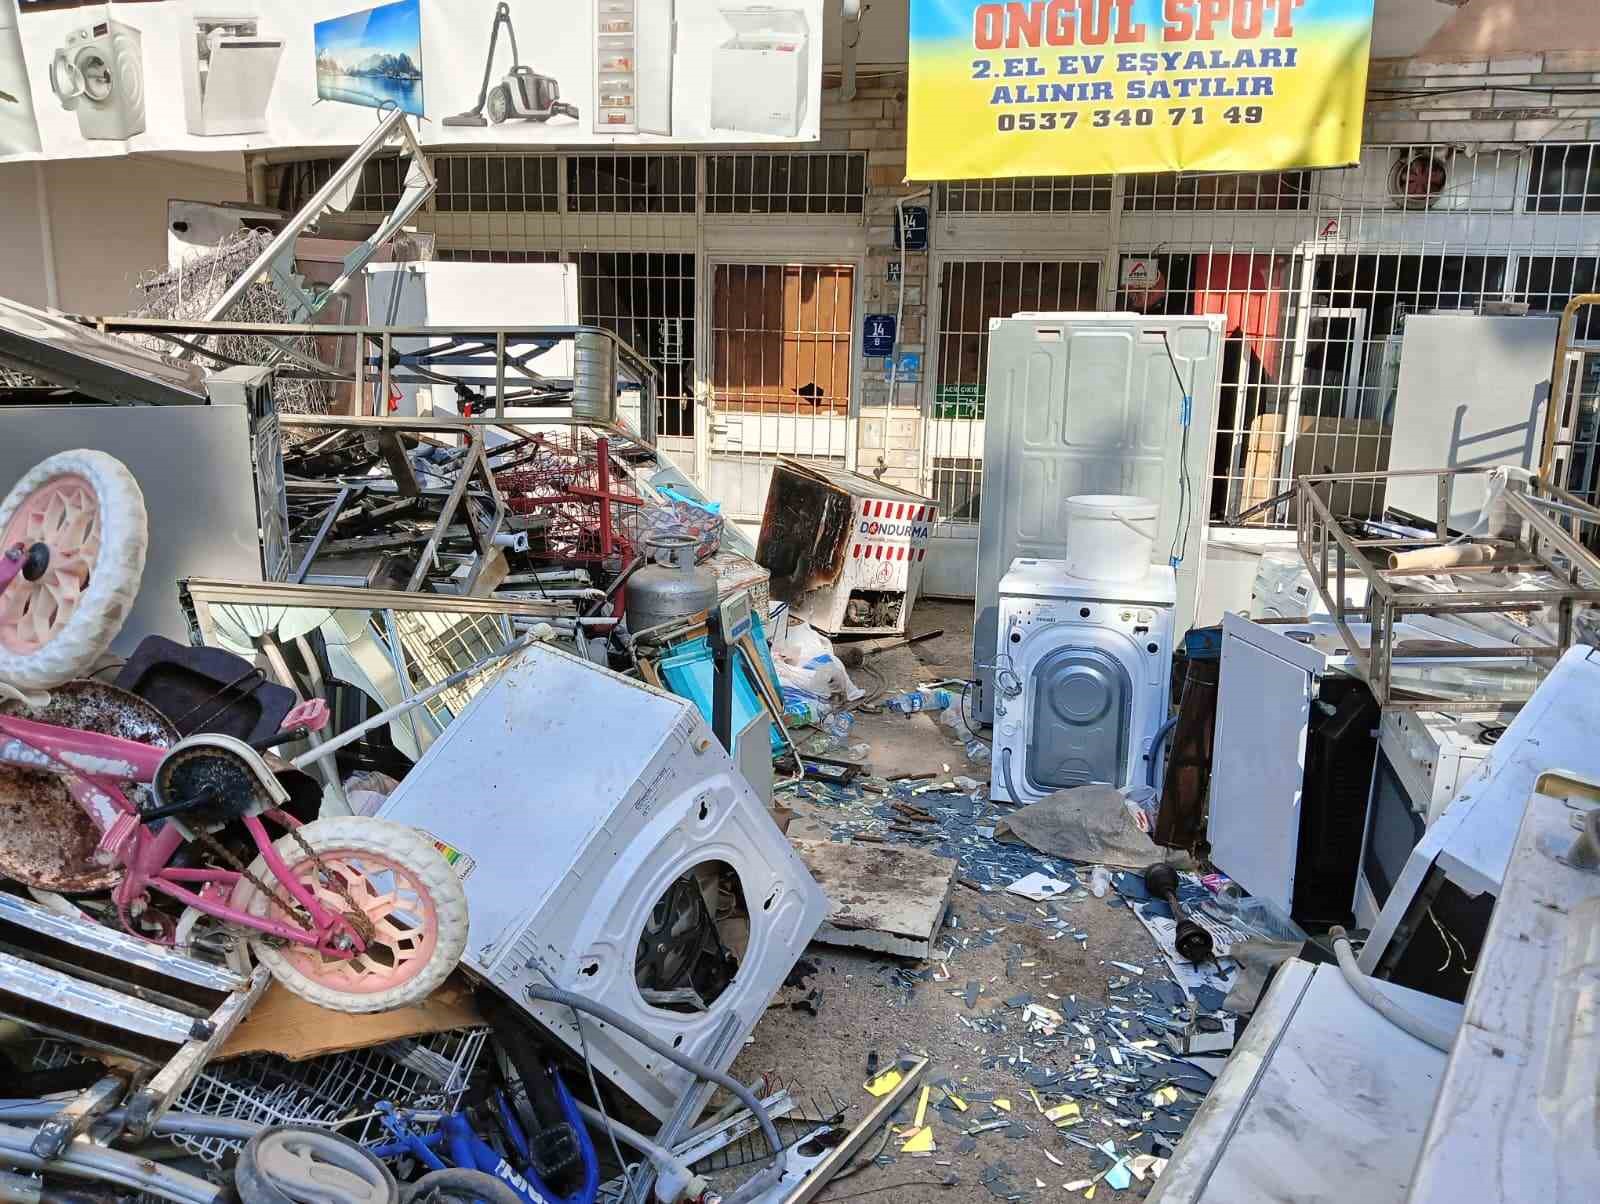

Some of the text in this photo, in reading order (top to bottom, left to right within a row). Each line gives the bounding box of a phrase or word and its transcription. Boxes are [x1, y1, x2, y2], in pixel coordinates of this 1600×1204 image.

[1163, 0, 1304, 43] SPOT
[971, 47, 1298, 79] 2.EL EV EŞYALARI
[990, 77, 1274, 105] ALINIR SATILIR
[998, 105, 1263, 131] 0537 340 71 49
[903, 214, 916, 228] 14
[905, 230, 913, 240] A
[872, 322, 885, 336] 14
[860, 521, 929, 539] DONDURMA
